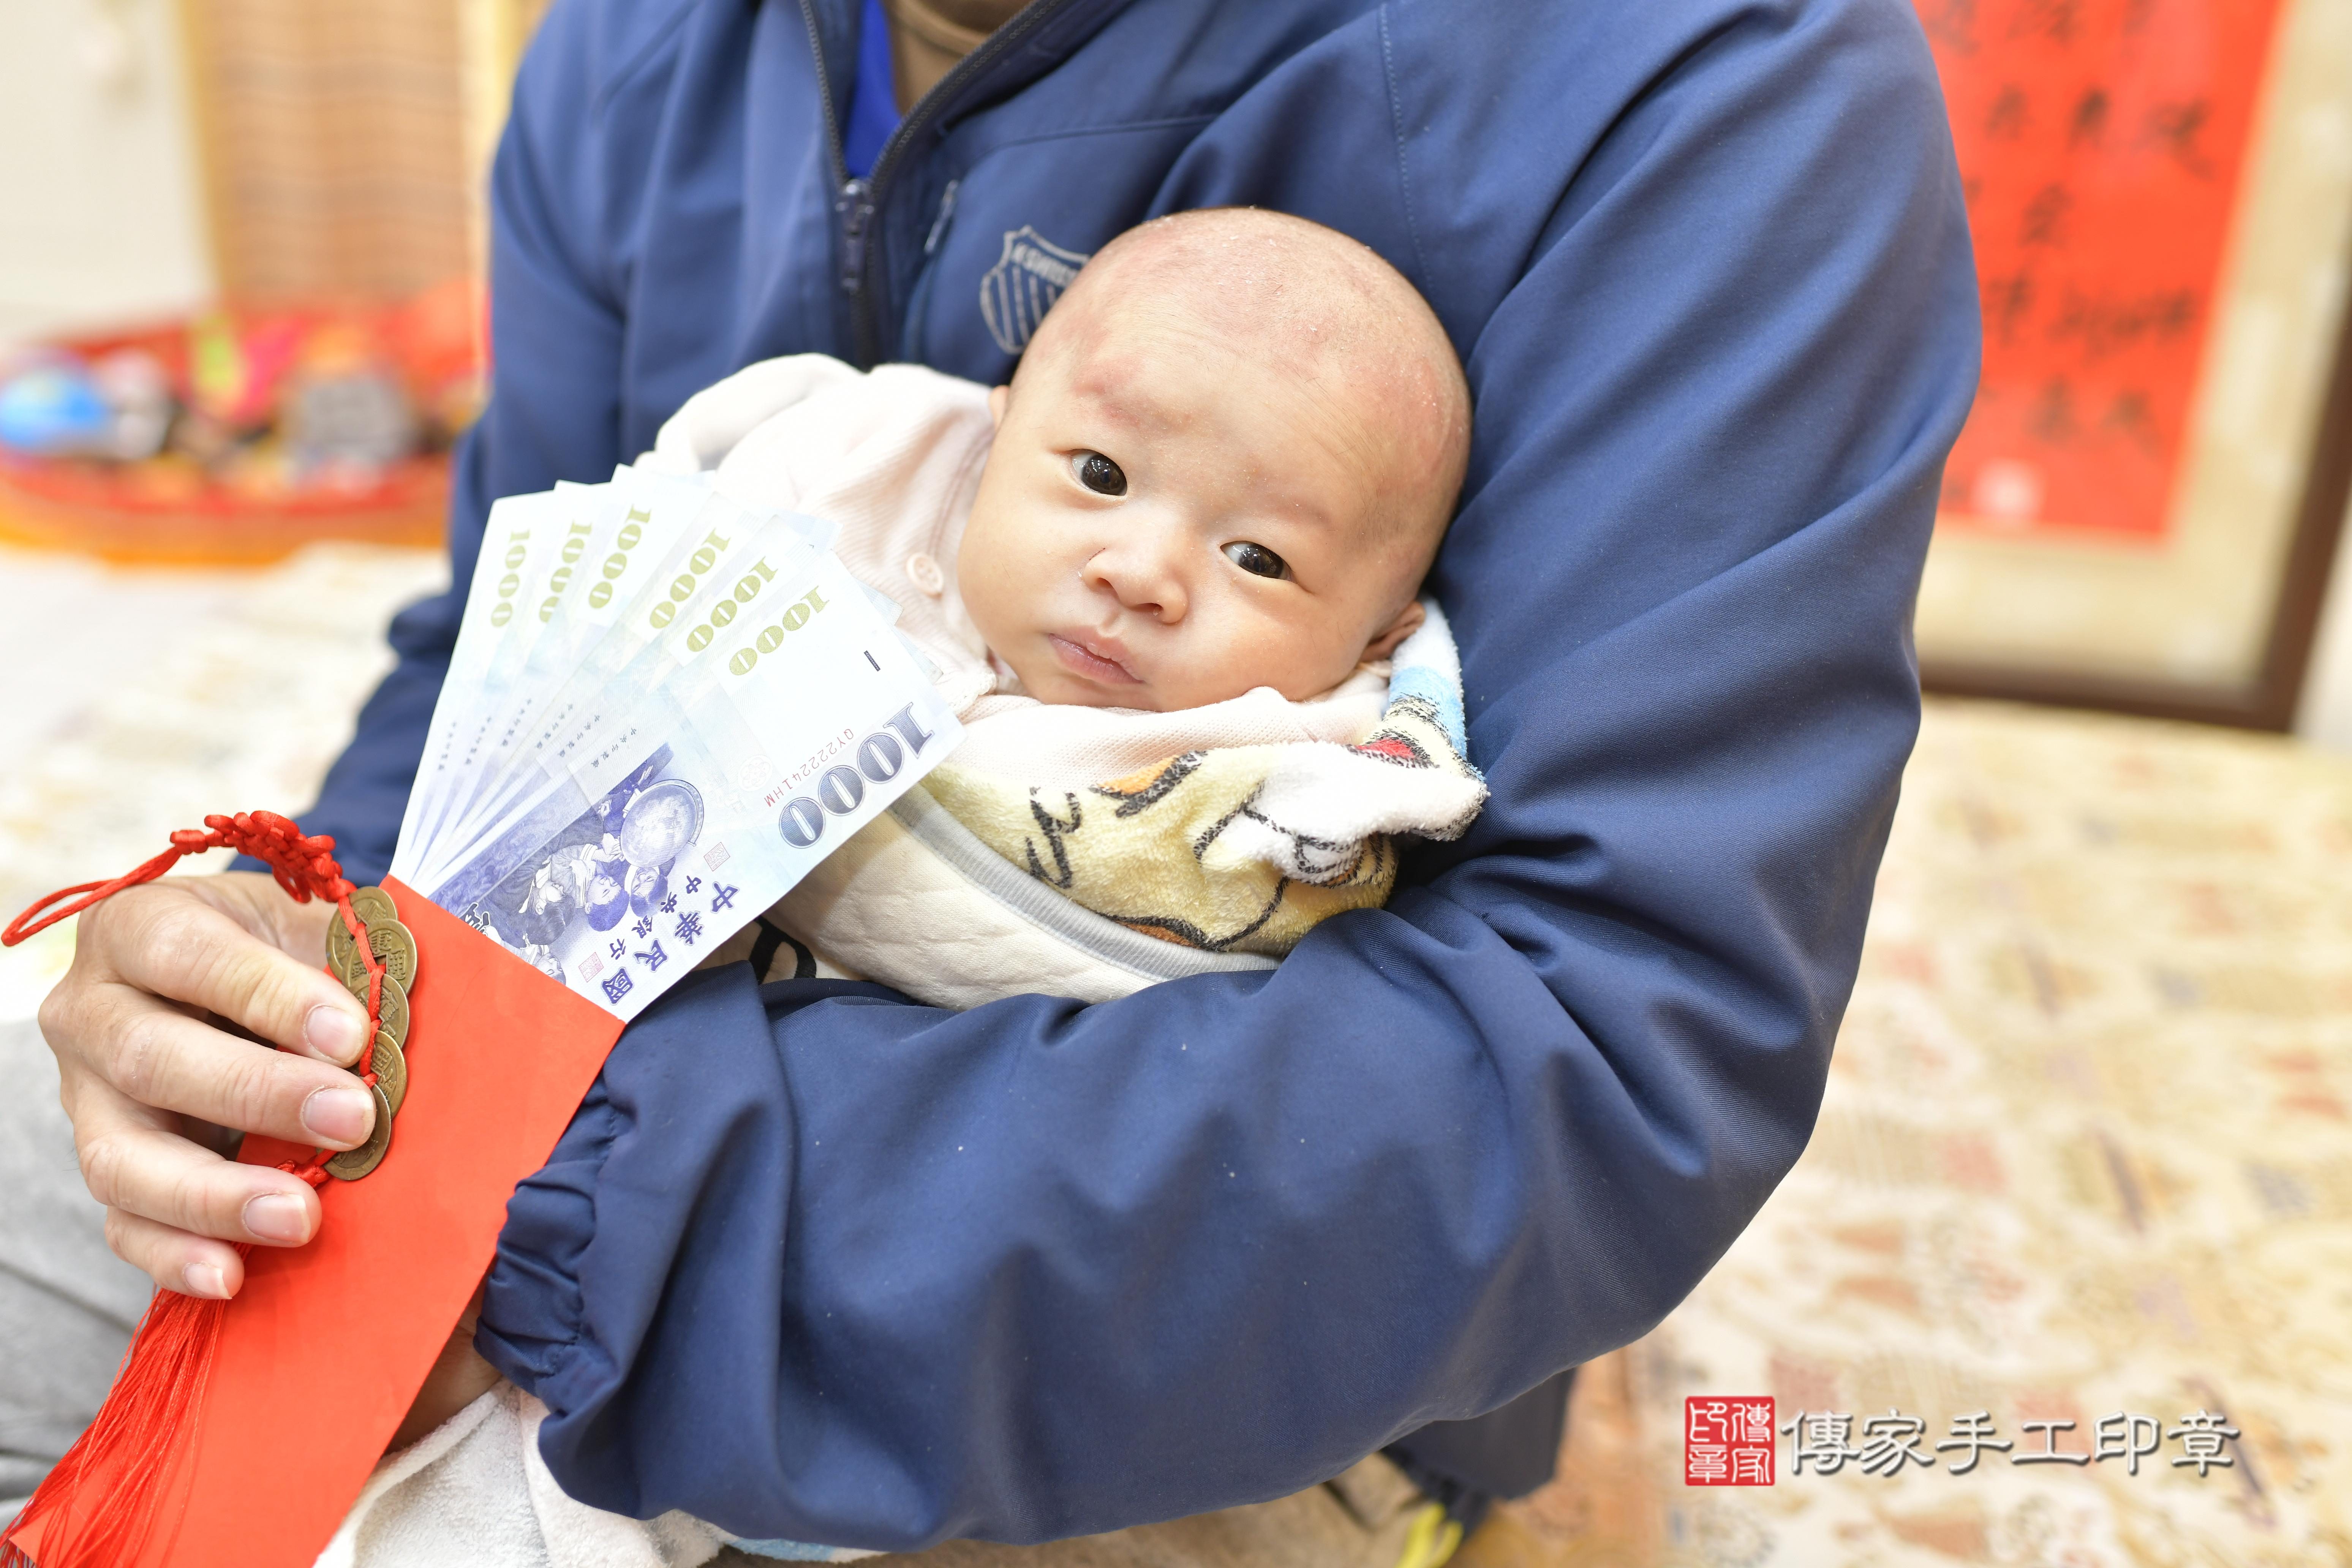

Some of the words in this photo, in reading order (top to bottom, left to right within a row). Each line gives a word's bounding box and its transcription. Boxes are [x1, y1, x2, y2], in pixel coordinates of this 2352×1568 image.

[491, 529, 530, 627] 1000
[588, 504, 651, 609] 1000
[650, 527, 730, 629] 1000
[687, 556, 778, 652] 1000
[729, 585, 830, 675] 1000
[591, 727, 637, 768] 中央印製廠
[764, 729, 854, 807] QY222241HM
[779, 702, 934, 849] 1000
[601, 882, 740, 1005] 中華民國
[610, 876, 701, 959] 中央銀行
